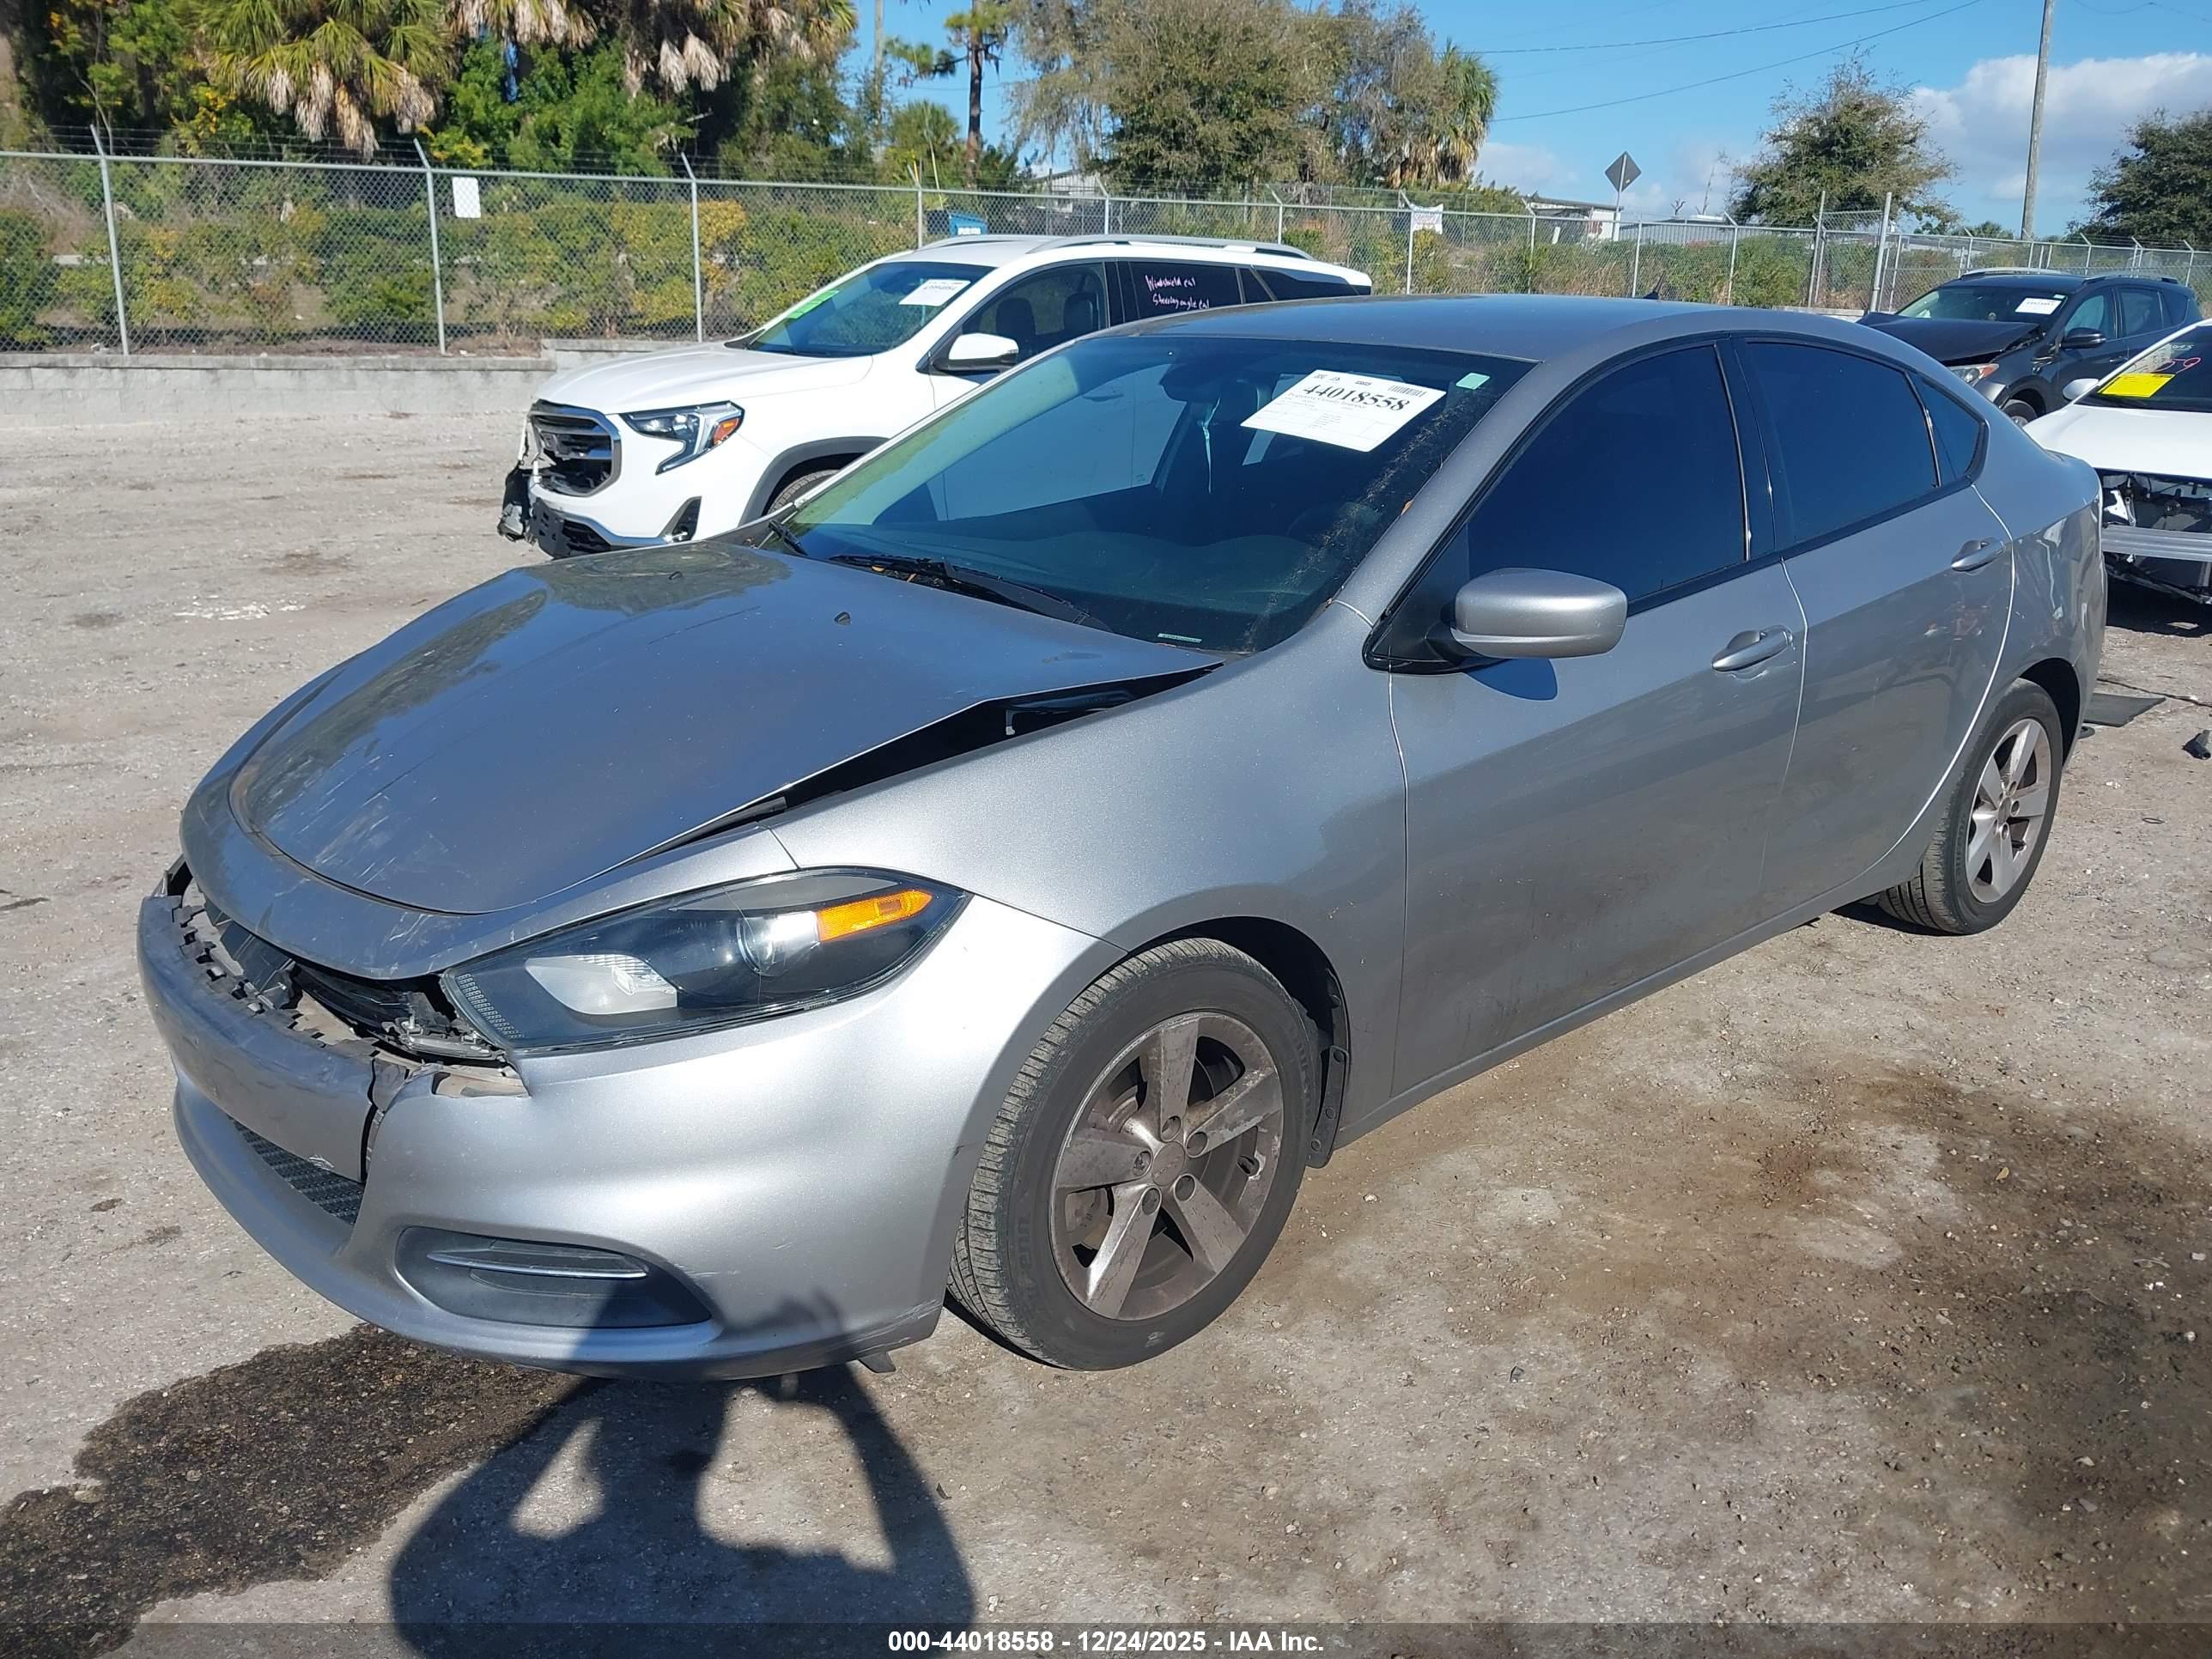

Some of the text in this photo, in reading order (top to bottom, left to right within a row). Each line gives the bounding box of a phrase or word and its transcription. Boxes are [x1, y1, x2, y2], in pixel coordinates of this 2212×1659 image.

[1145, 275, 1182, 291] Windshield
[1152, 293, 1179, 309] Steering
[1180, 297, 1197, 310] angle
[1304, 384, 1410, 411] 44018558
